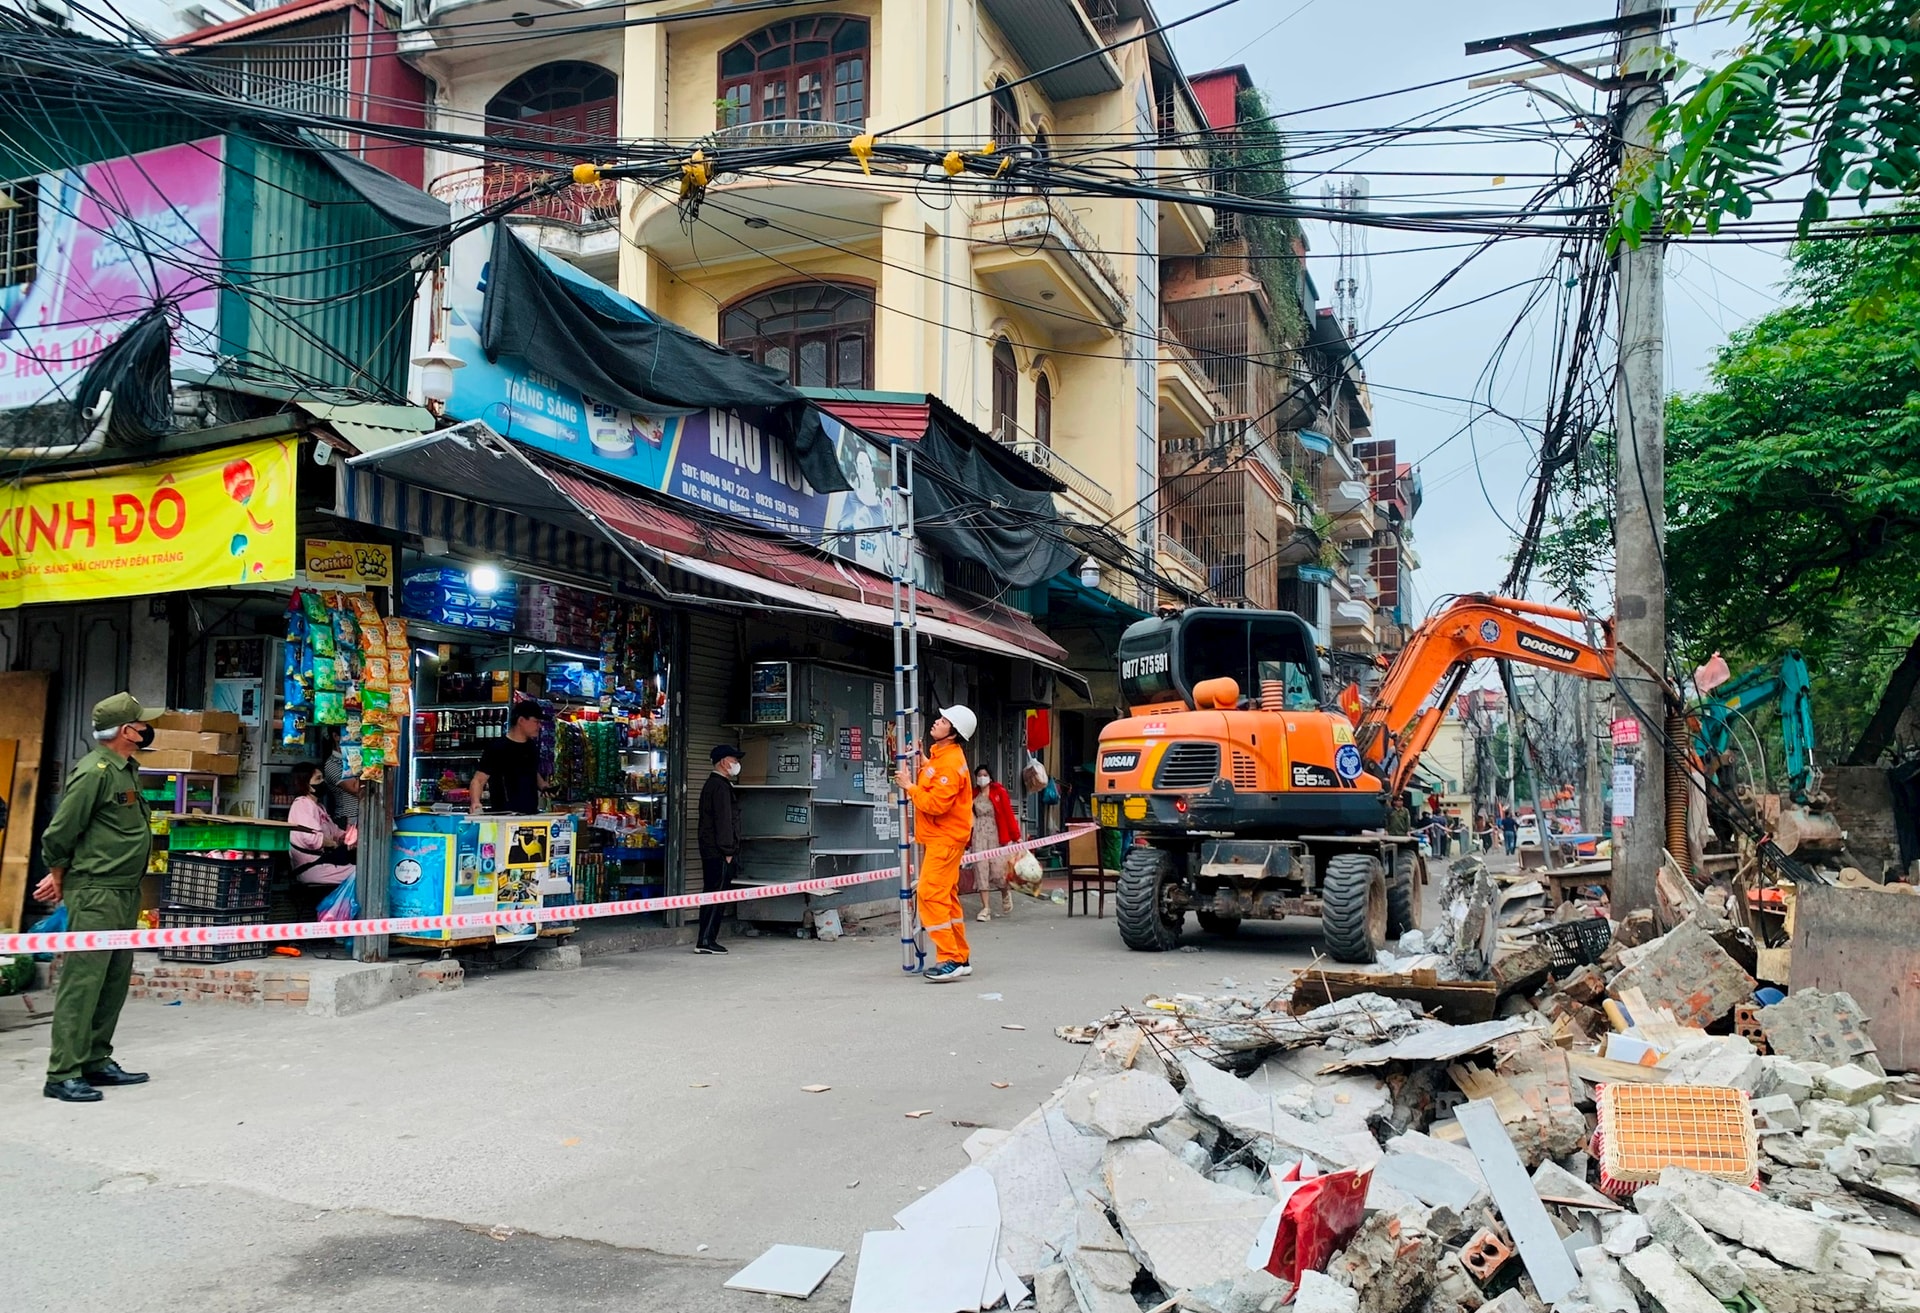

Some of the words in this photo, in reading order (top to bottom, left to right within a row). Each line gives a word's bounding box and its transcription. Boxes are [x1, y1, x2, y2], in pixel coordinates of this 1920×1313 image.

[547, 396, 578, 424] SÁNG
[593, 404, 619, 419] SPY
[709, 406, 761, 475] HẬU
[700, 470, 720, 489] 0904
[721, 478, 735, 494] 947
[736, 484, 750, 500] 223
[108, 473, 187, 545] ĐÔ
[701, 488, 712, 503] 66
[712, 492, 728, 510] Kim
[860, 539, 877, 554] SPY
[1520, 636, 1575, 660] DOOSAN
[1122, 658, 1139, 680] 0977
[1103, 755, 1136, 768] DOOSAN
[1293, 765, 1313, 774] DX
